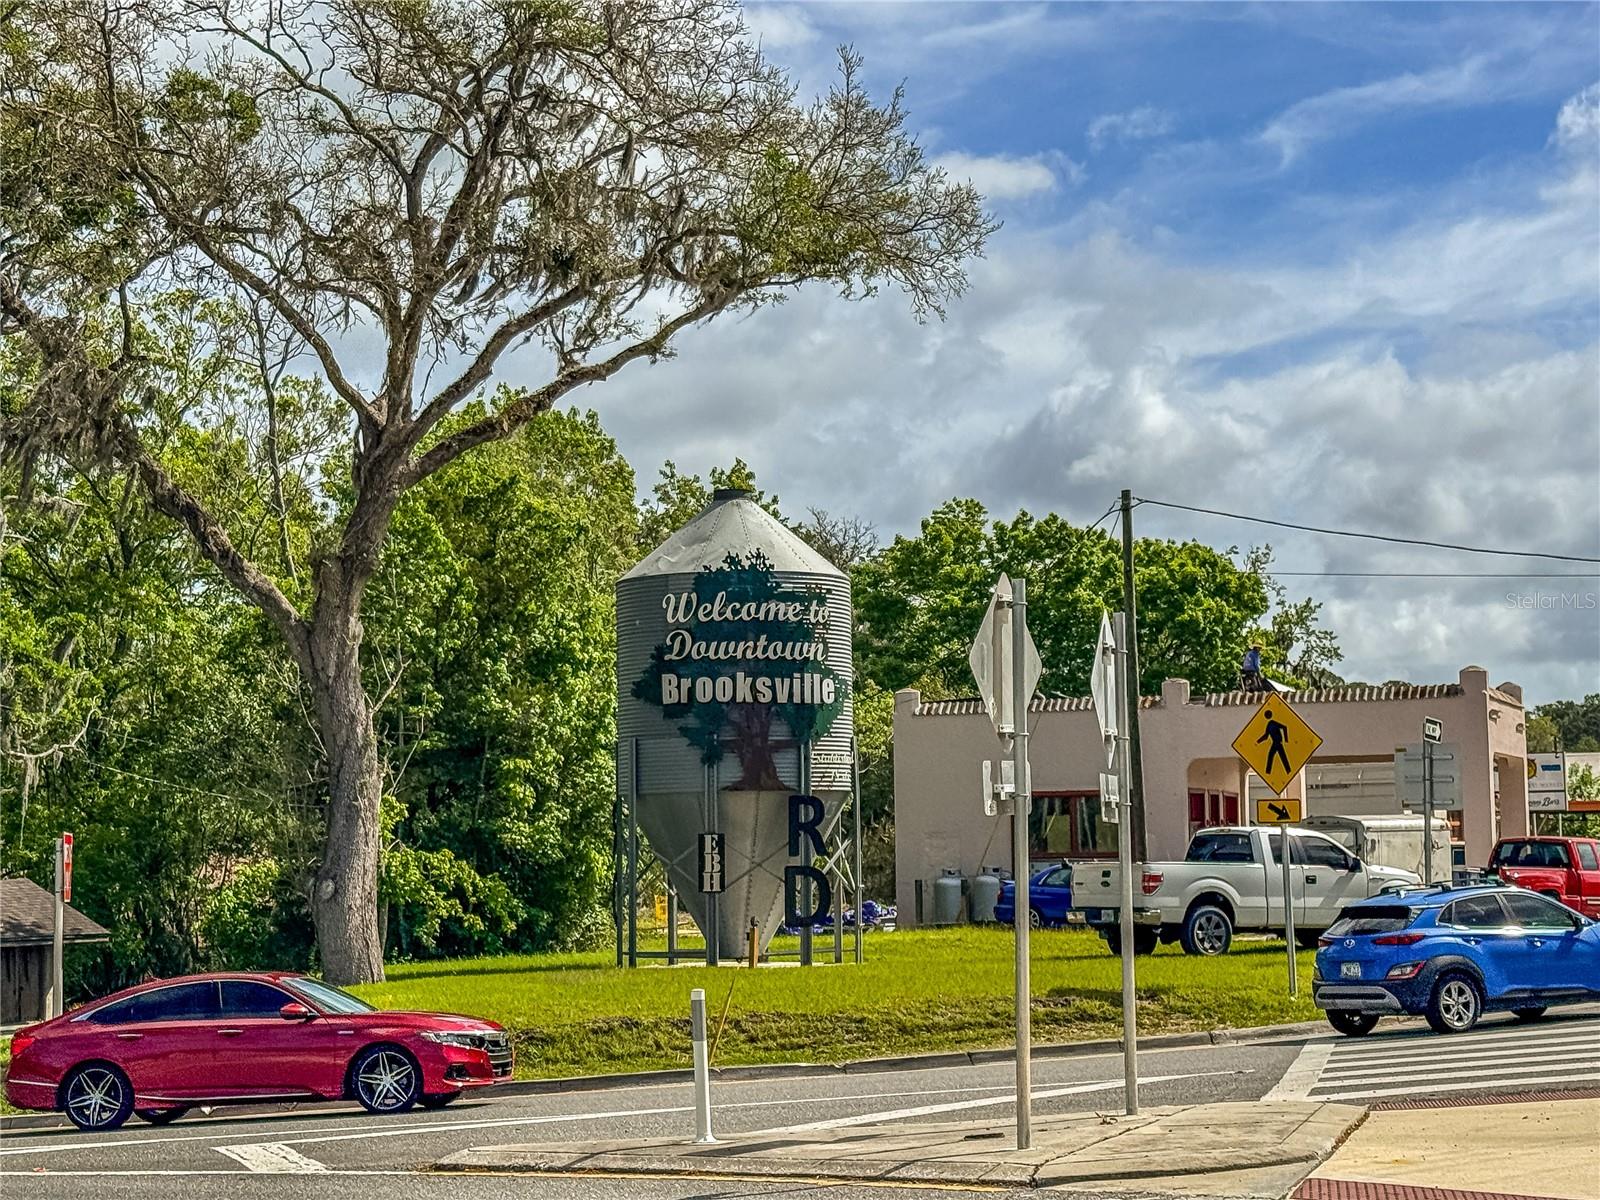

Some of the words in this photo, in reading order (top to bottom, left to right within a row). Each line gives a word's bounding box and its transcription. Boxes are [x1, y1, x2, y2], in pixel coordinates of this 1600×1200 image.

[662, 591, 802, 623] Welcome
[809, 600, 829, 623] to
[664, 630, 825, 661] Downtown
[661, 671, 835, 704] Brooksville
